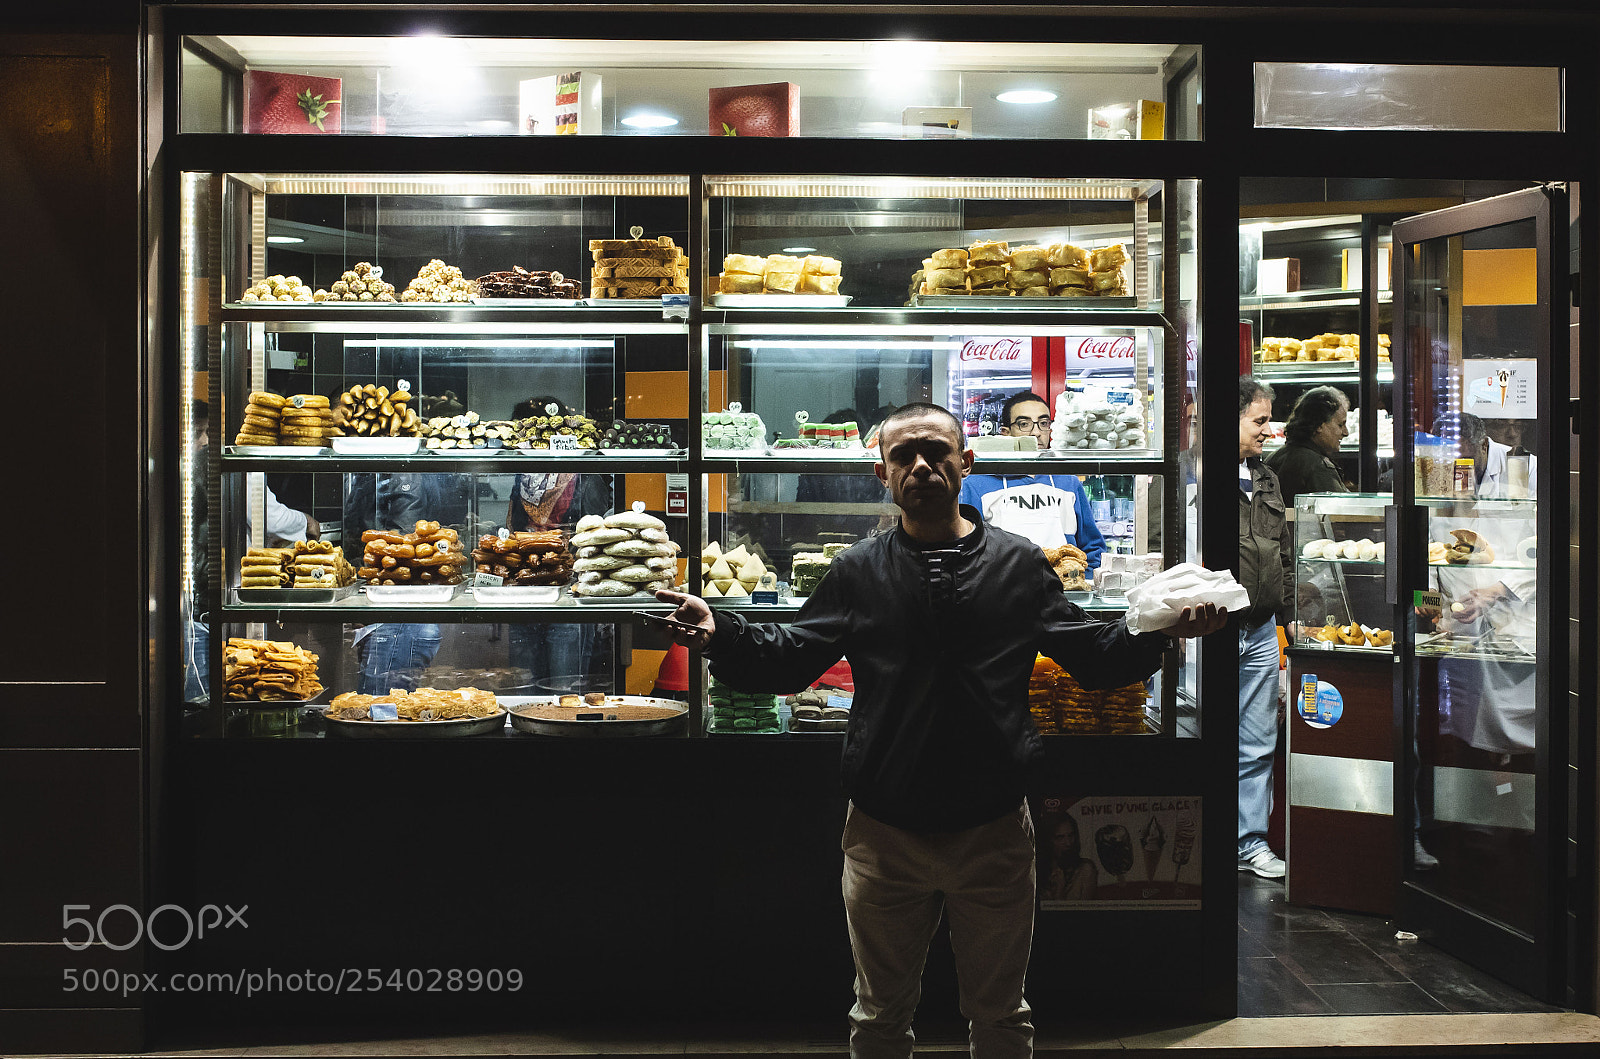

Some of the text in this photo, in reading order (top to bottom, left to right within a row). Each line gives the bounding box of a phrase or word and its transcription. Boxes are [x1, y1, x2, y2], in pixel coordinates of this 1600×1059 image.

[960, 338, 1023, 362] Coca-Cola
[1422, 595, 1441, 607] POUSSEZ
[1080, 804, 1113, 816] ENVIE
[1116, 801, 1148, 815] D'UNE
[1152, 799, 1190, 812] GLACE
